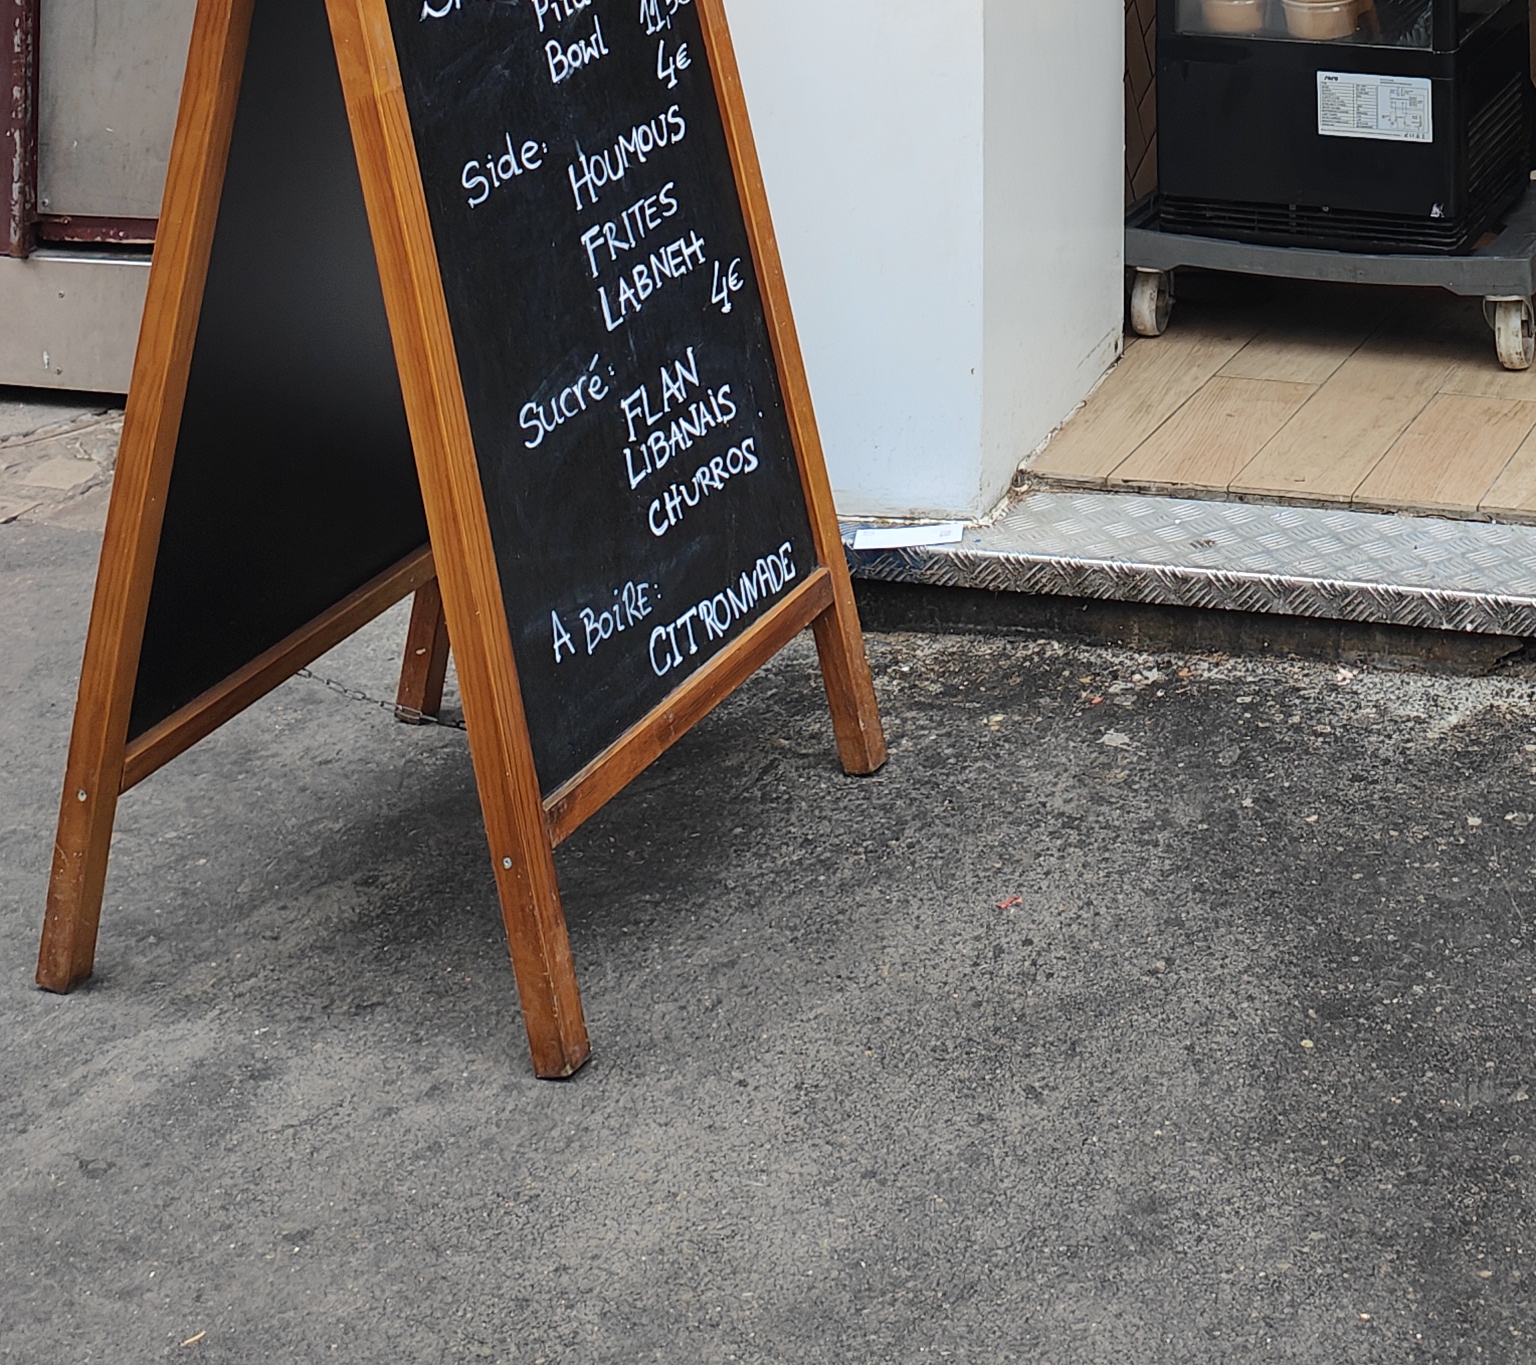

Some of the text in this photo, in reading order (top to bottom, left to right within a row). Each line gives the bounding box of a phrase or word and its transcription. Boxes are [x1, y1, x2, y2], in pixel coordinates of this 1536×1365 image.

[545, 15, 609, 84] Bowl
[657, 40, 692, 89] 4€
[461, 105, 686, 212] Side: HOUMOUS
[581, 182, 678, 279] FRITES
[598, 231, 706, 332] LABNEH
[711, 258, 745, 314] 4€
[621, 347, 699, 443] FLAN
[648, 438, 759, 537] CHURROS
[552, 610, 576, 664] A
[649, 542, 796, 677] CITRONNADE
